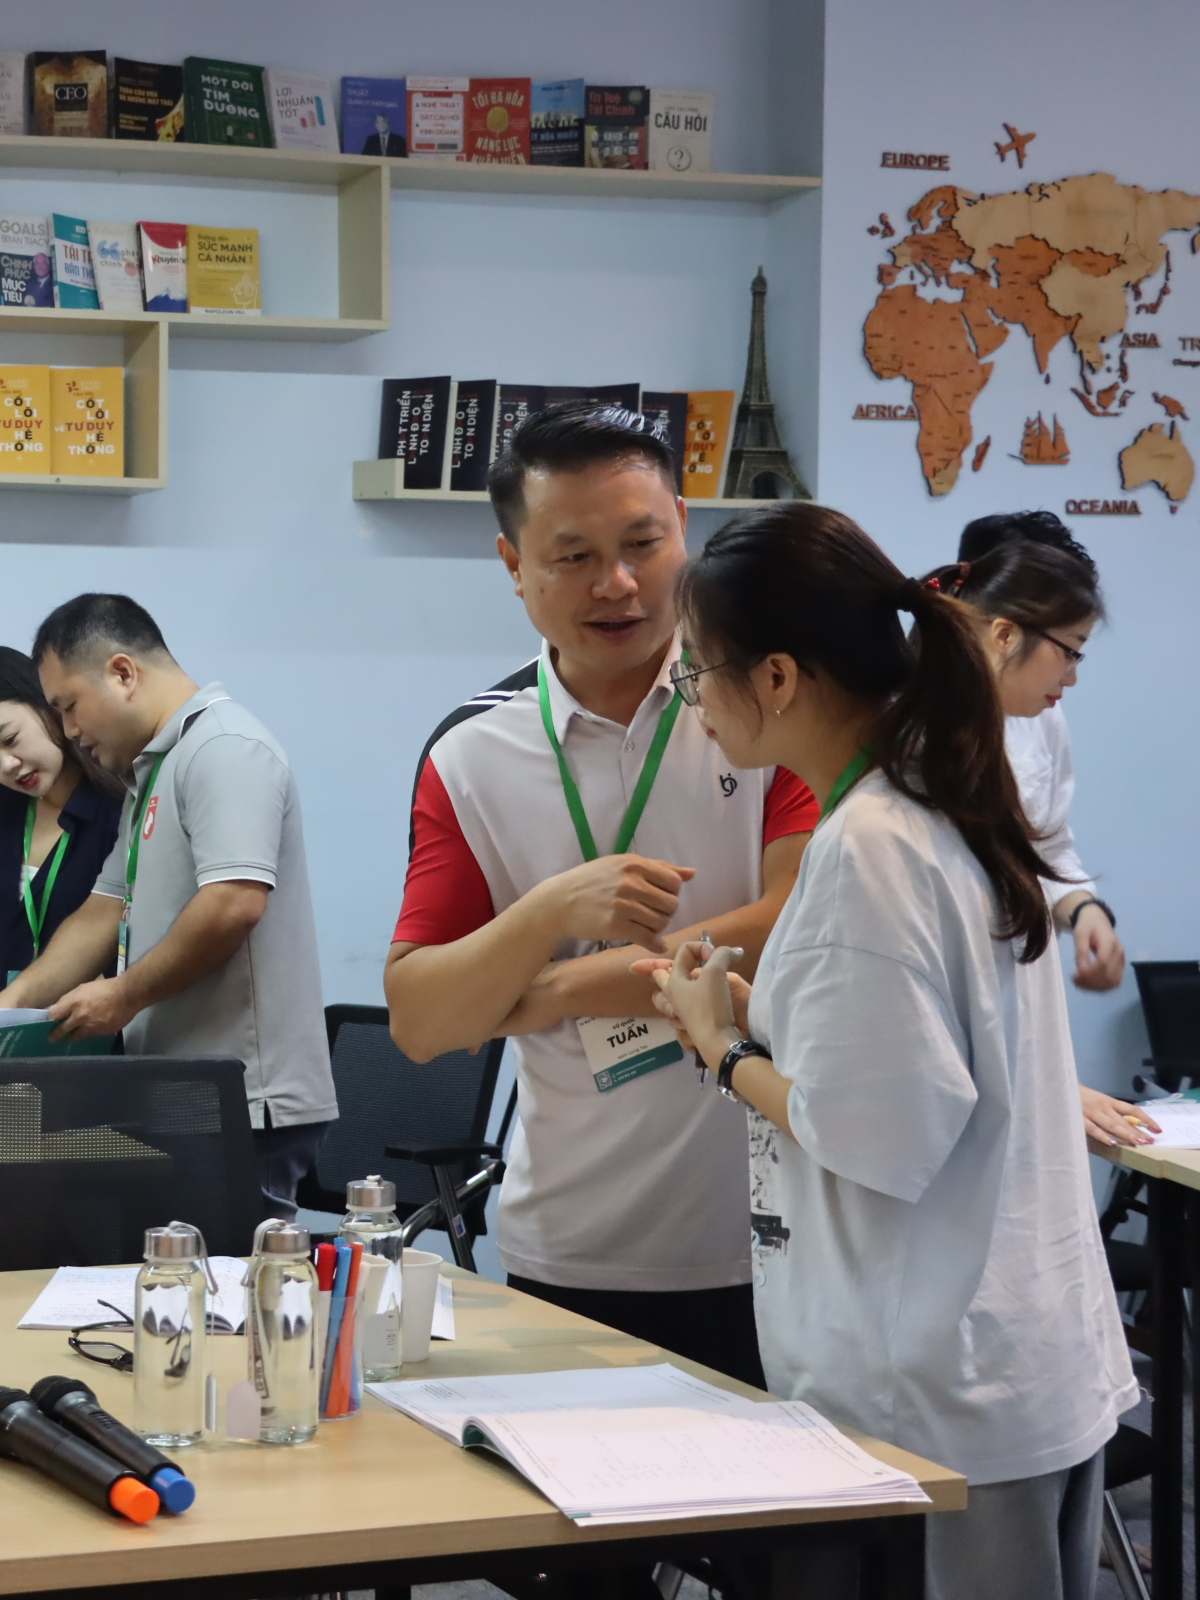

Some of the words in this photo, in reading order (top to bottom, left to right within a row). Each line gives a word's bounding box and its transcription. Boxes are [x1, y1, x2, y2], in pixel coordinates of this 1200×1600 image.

[55, 86, 87, 100] CEO
[881, 152, 950, 171] EUROPE
[1, 234, 22, 244] BRIAN
[198, 240, 218, 252] SỨC
[221, 243, 253, 253] MẠNH
[1, 255, 33, 270] CHINH
[198, 252, 212, 263] CÁ
[215, 252, 246, 263] NHÂN
[1120, 332, 1161, 348] ASIA
[4, 394, 32, 407] CỐT
[76, 395, 105, 409] CỐT
[397, 390, 411, 424] TRIỂN
[15, 406, 37, 418] LÕI
[87, 408, 110, 420] LÕI
[422, 394, 435, 421] DIỆN
[466, 398, 480, 426] DIỆN
[853, 404, 919, 420] AFRICA
[15, 420, 43, 429] DUY
[65, 421, 84, 431] TƯ
[87, 421, 114, 431] DUY
[15, 429, 33, 441] HỆ
[86, 431, 104, 443] HỆ
[68, 442, 115, 455] THỐNG
[1066, 500, 1141, 515] OCEANIA
[607, 1023, 649, 1048] TUẤN
